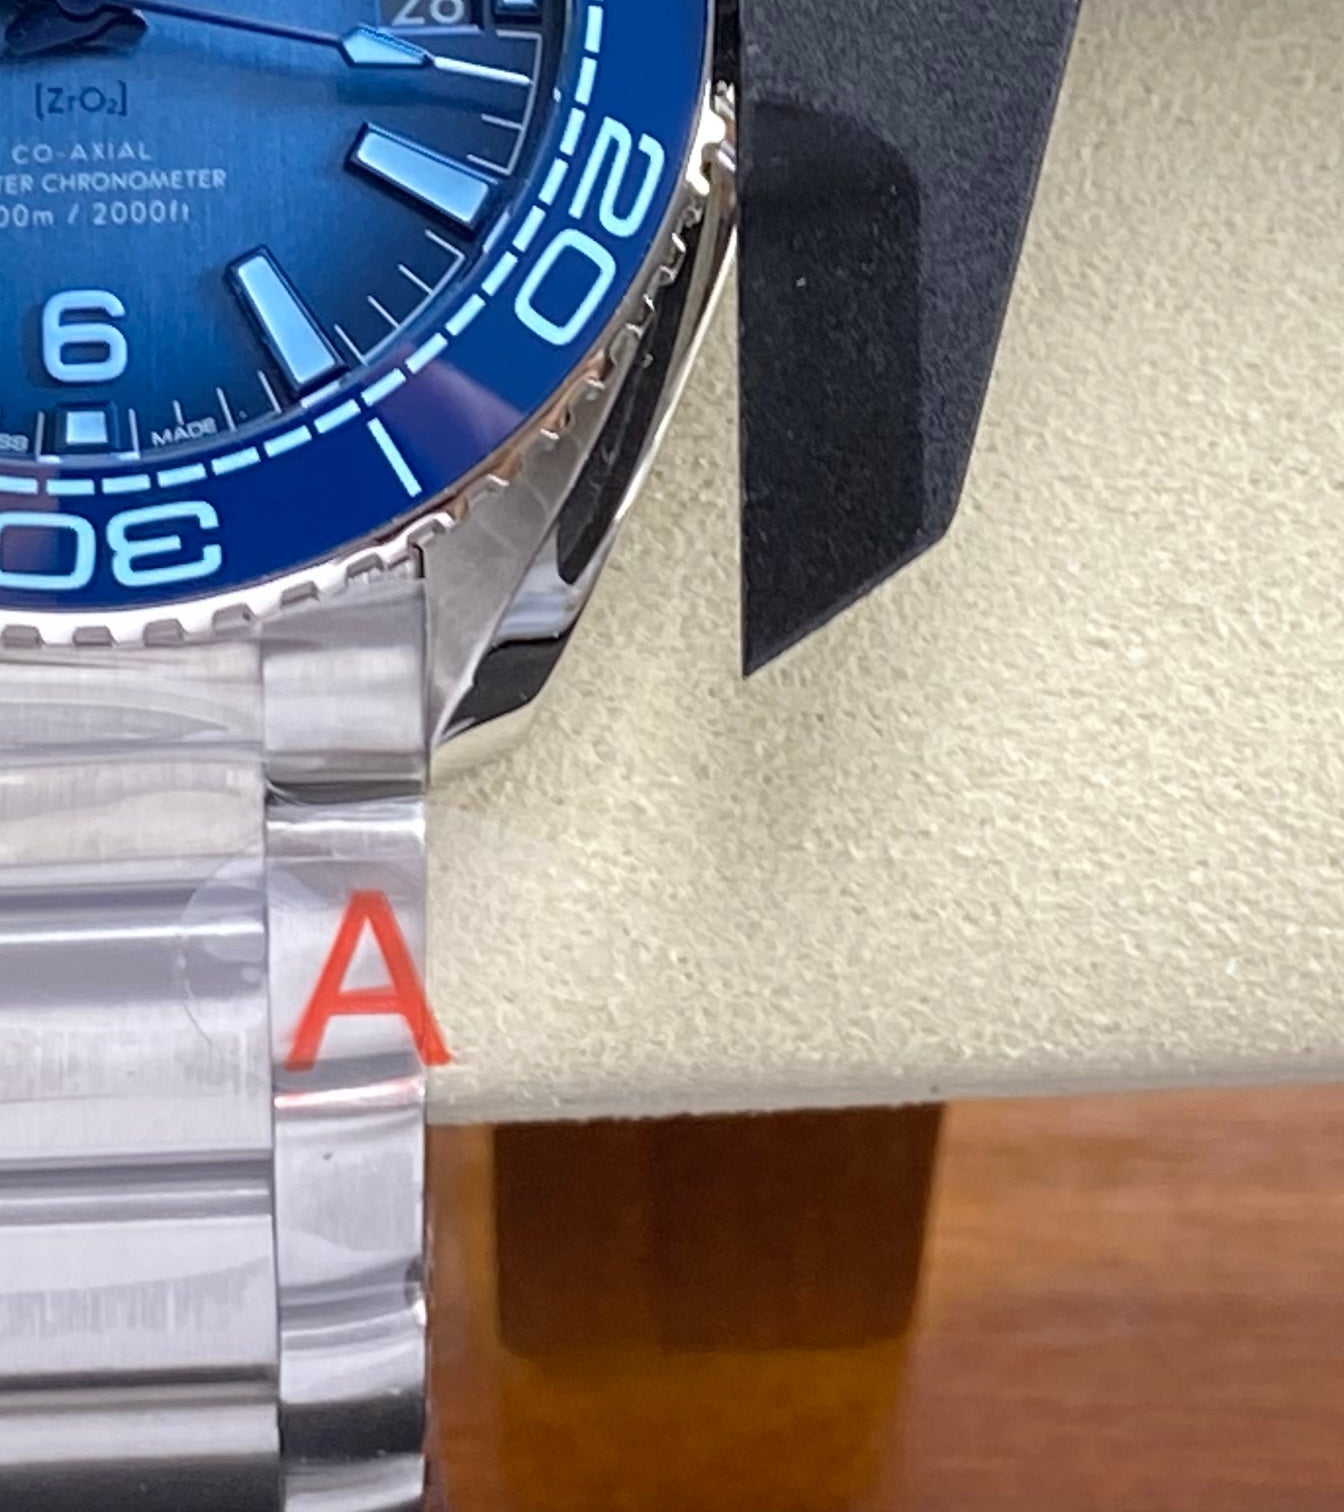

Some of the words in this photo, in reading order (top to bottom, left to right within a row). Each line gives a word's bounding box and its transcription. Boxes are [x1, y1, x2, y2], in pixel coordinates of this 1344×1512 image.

[11, 140, 154, 166] CO-AXIAL
[41, 168, 227, 194] CHRONOMETER
[92, 198, 190, 226] 2000ft
[514, 115, 666, 347] 20
[41, 289, 128, 383] 6
[150, 415, 218, 447] MADE
[282, 888, 453, 1073] A
